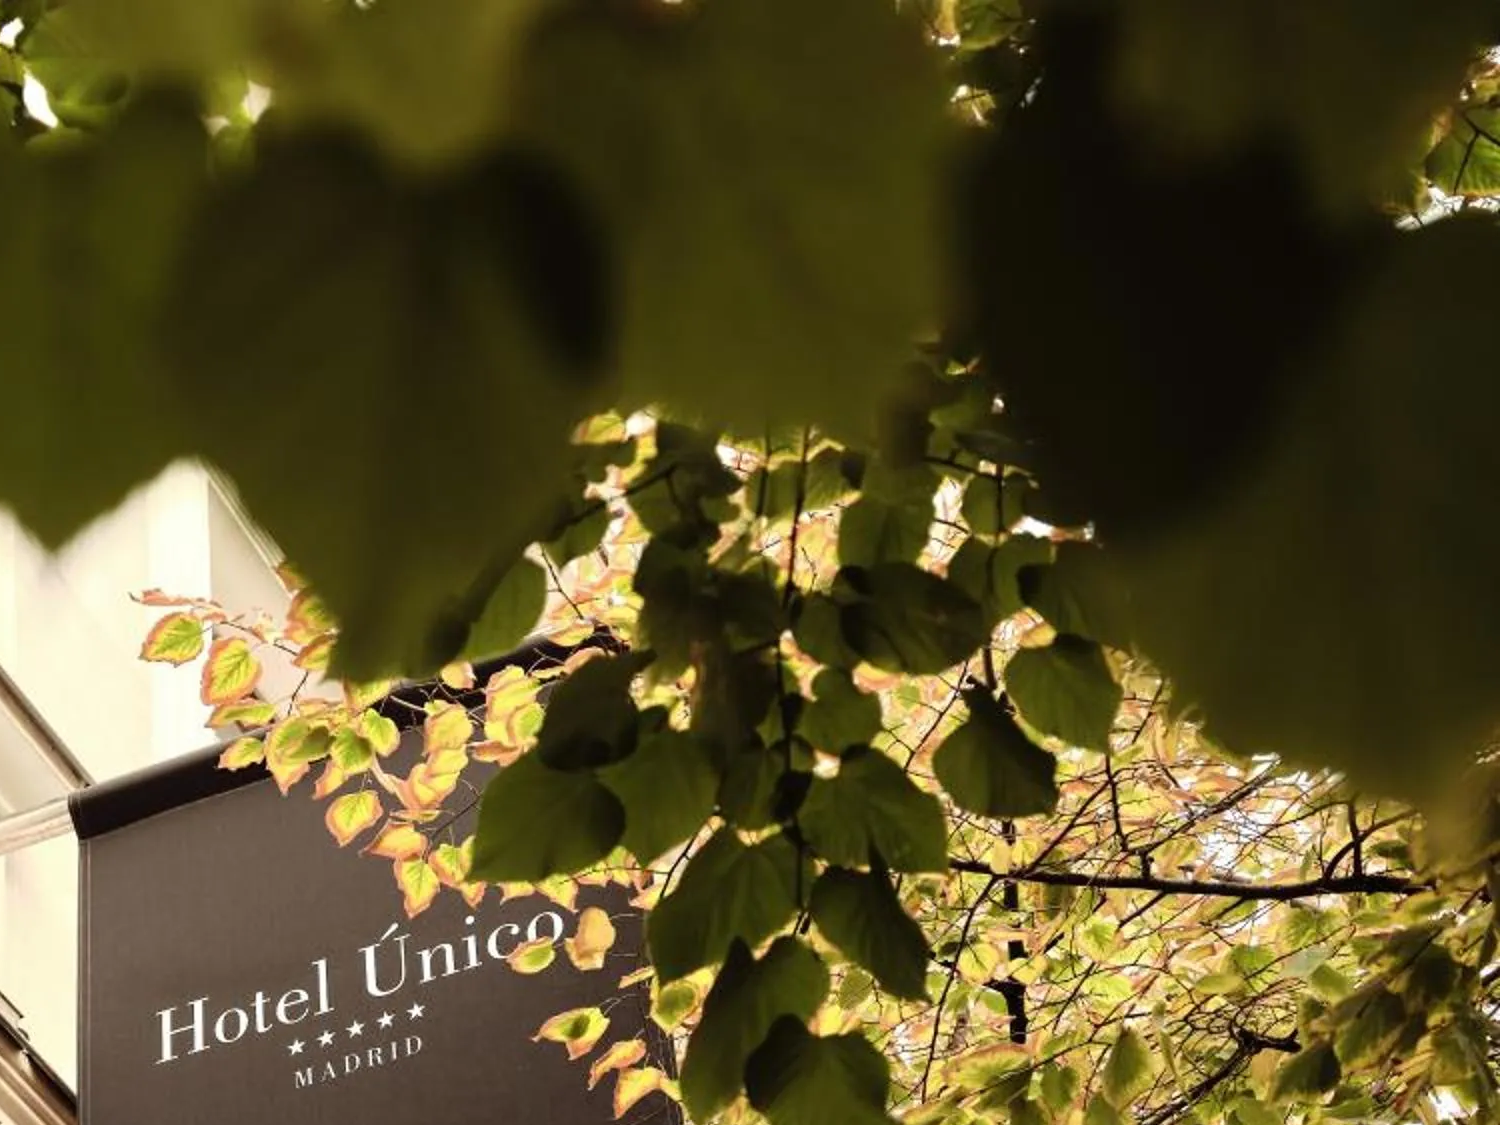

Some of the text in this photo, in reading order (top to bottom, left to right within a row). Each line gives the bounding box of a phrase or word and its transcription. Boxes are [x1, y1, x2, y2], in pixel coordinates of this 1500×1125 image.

[155, 911, 565, 1064] Hotel Único
[293, 1034, 424, 1088] MADRID
